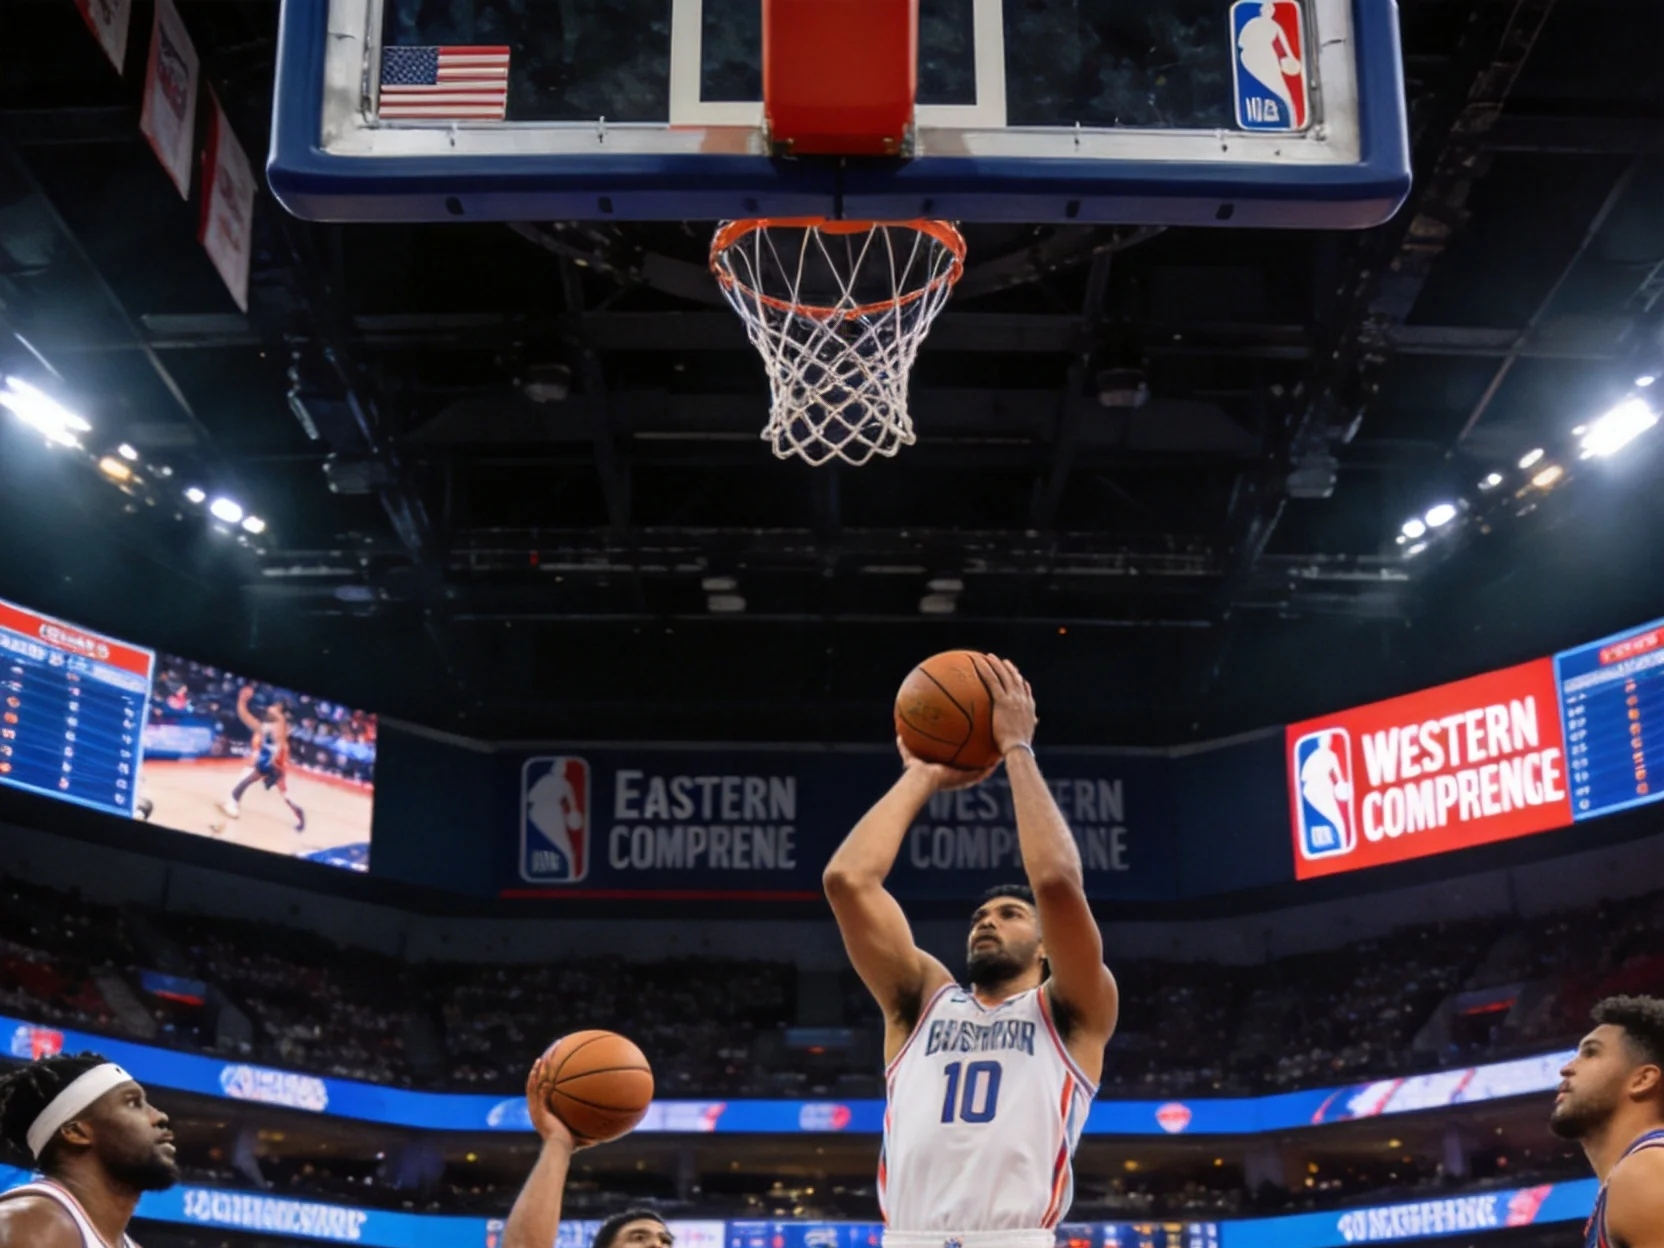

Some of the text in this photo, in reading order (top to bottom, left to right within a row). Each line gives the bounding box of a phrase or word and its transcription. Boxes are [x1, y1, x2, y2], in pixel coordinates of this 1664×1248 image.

[1361, 695, 1540, 787] WESTERN
[614, 770, 797, 820] EASTERN
[608, 825, 797, 870] COMPRENE
[940, 1060, 1003, 1124] 10
